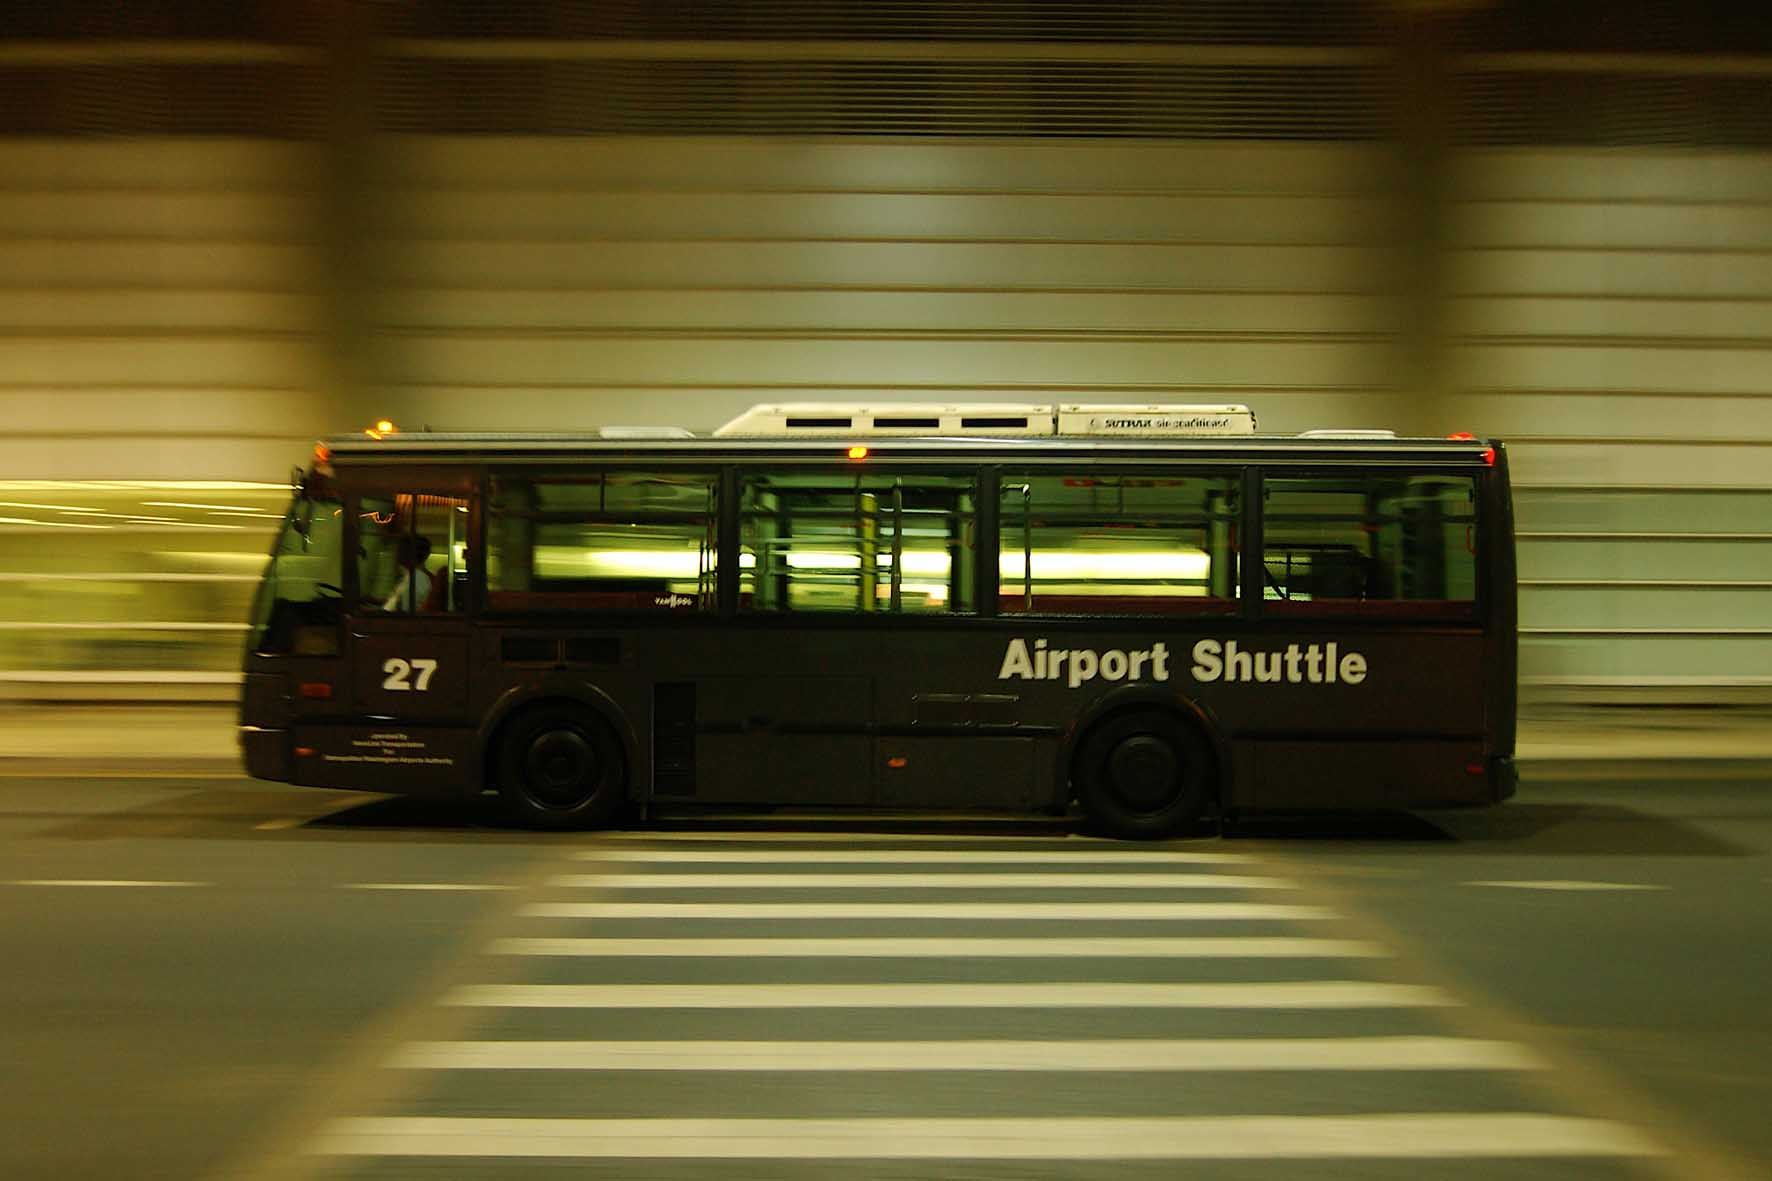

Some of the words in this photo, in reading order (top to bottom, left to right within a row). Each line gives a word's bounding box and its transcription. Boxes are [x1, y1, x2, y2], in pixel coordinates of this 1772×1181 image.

[384, 659, 436, 691] 27
[999, 639, 1169, 688] Airport
[1192, 640, 1367, 684] Shuttle
